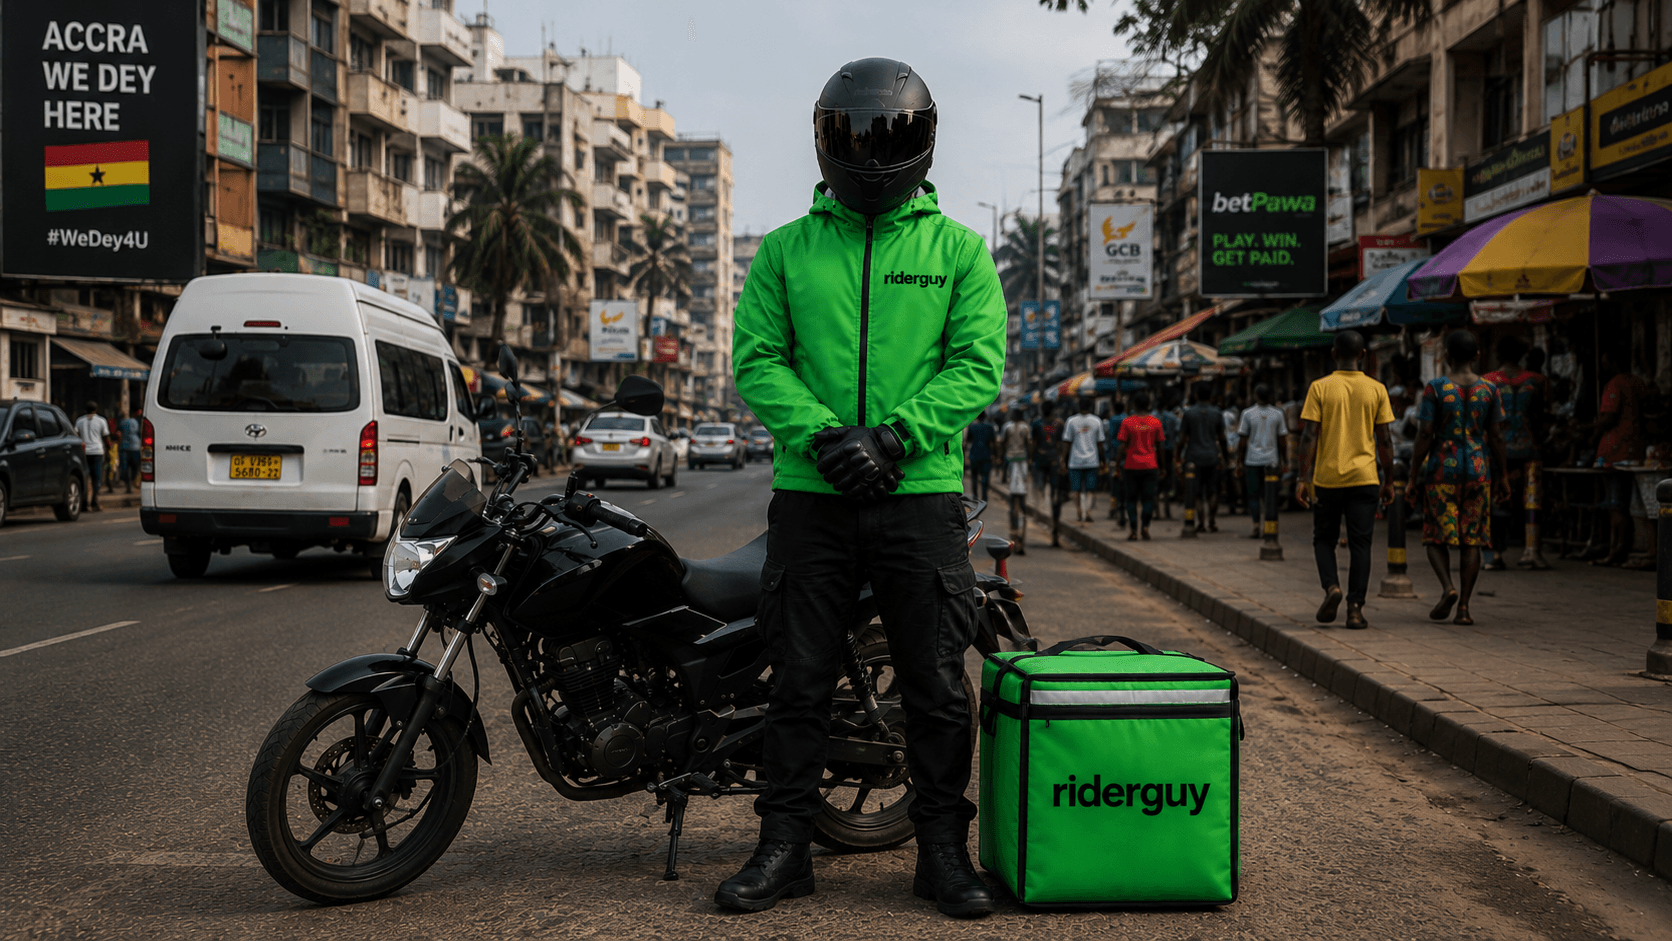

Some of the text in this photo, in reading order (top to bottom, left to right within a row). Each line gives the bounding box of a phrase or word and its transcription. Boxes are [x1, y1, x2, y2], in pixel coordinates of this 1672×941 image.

[42, 21, 149, 54] ACCRA
[42, 61, 156, 94] WE DEY
[44, 100, 120, 131] HERE
[1212, 192, 1316, 213] betPawa
[47, 228, 149, 252] #WeDey4U
[1106, 243, 1141, 257] GCB
[1212, 233, 1301, 249] PLAY. WIN.
[1212, 250, 1295, 266] GET PAID.
[884, 270, 948, 288] riderguy
[1053, 774, 1211, 816] riderguy
